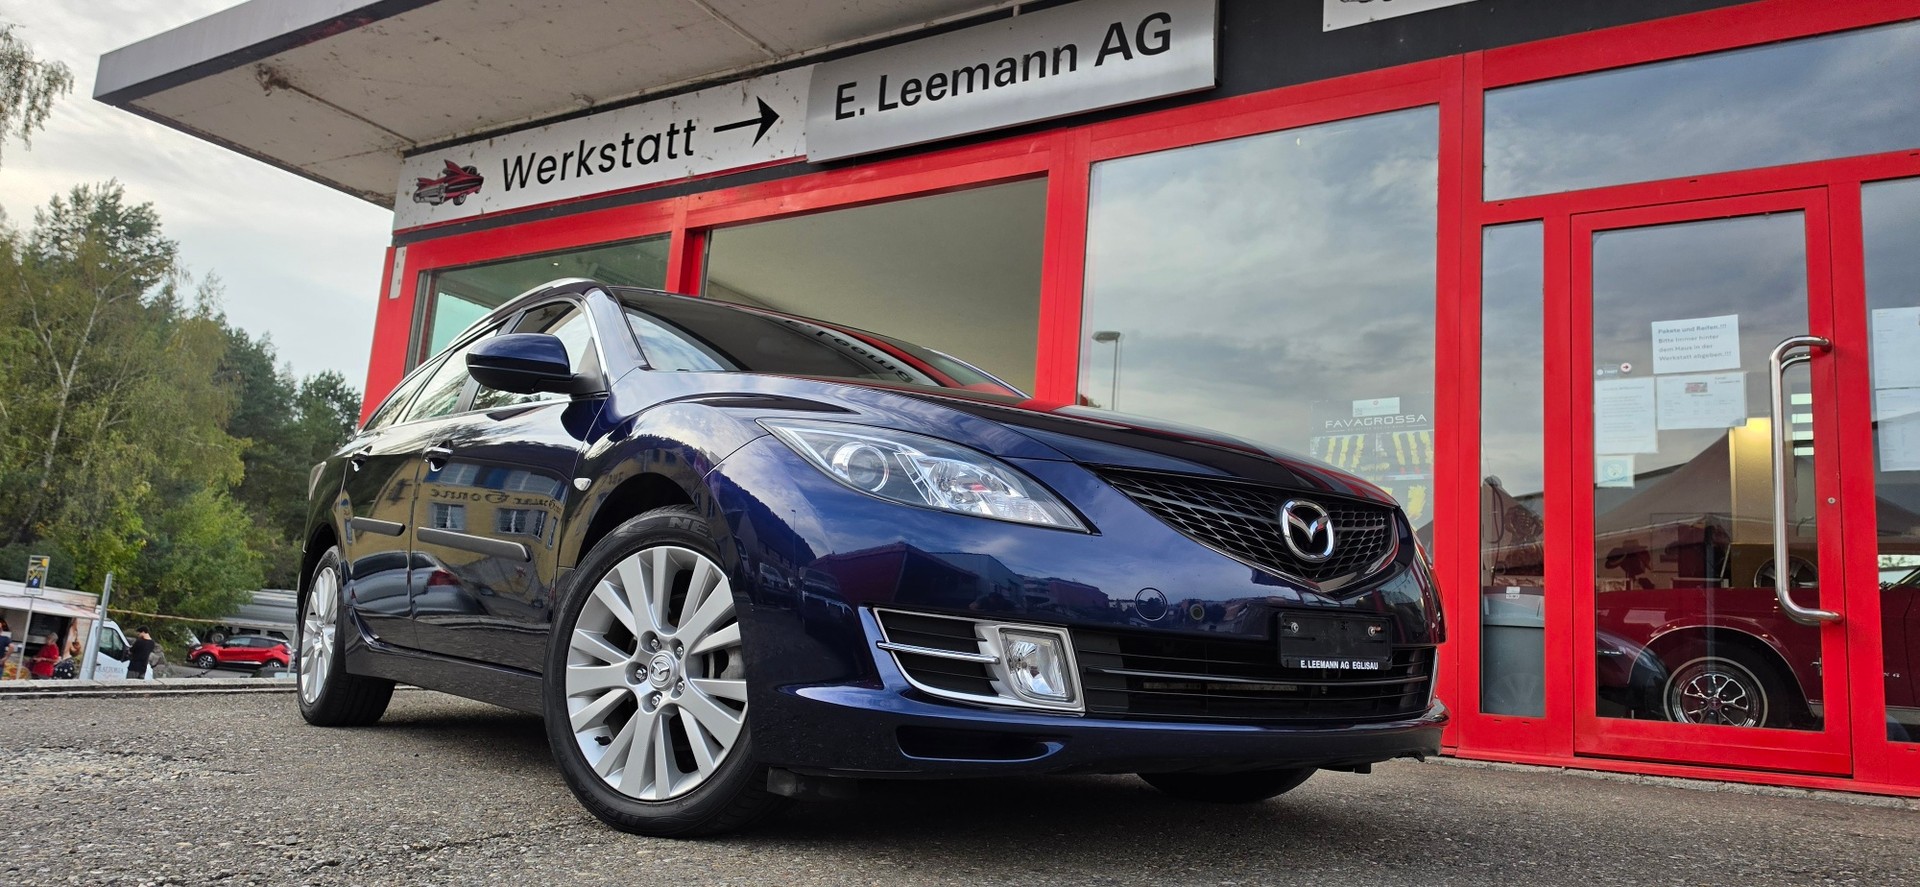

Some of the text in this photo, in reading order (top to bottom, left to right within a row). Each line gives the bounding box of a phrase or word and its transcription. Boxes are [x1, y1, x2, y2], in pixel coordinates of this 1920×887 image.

[835, 11, 1172, 121] E. Leemann AG
[502, 119, 696, 192] Werkstatt
[1325, 414, 1427, 429] FAVAGROSSA
[1300, 660, 1379, 670] E. LEEMANN AG EGLISAU
